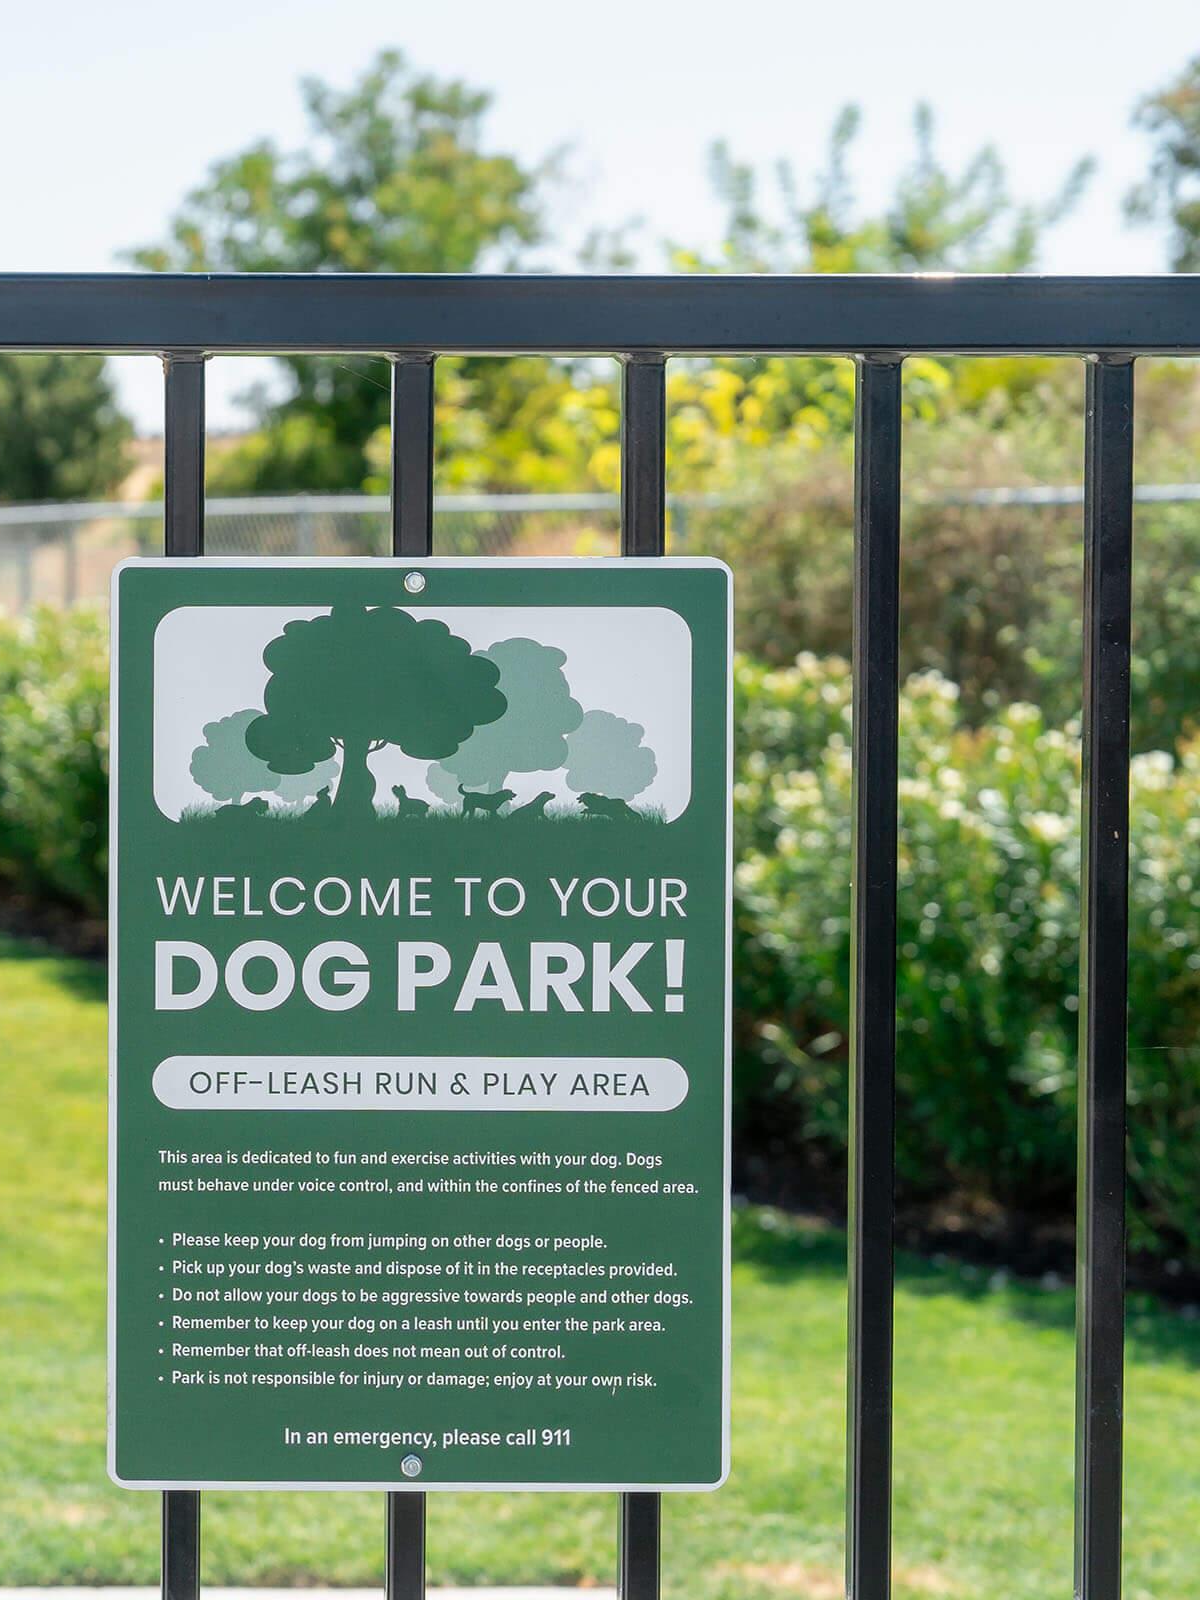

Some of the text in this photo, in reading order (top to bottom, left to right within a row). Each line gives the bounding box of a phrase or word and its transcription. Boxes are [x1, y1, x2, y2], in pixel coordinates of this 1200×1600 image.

[155, 876, 688, 918] WELCOME TO YOUR
[154, 938, 685, 1013] DOG PARK!
[189, 1071, 650, 1097] OFF-LEASH RUN & PLAY AREA
[158, 1149, 663, 1170] This area is dedicated to fun and exercise activities with your dog. Dogs
[158, 1177, 699, 1194] must behave under voice control, and within the confines of the fenced area.
[172, 1232, 608, 1252] Please keep your dog from jumping on other dogs or people.
[172, 1259, 203, 1274] Pick
[206, 1263, 225, 1278] up
[228, 1263, 262, 1278] your
[307, 1261, 352, 1275] waste
[354, 1261, 382, 1275] and
[385, 1260, 442, 1279] dispose
[445, 1261, 461, 1275] of
[463, 1261, 474, 1276] it
[477, 1260, 491, 1276] in
[494, 1261, 519, 1276] the
[522, 1262, 606, 1279] receptacles
[609, 1262, 678, 1280] provided.
[172, 1287, 693, 1308] Do not allow your dogs to be aggressive towards people and other dogs.
[172, 1315, 666, 1335] Remember to keep your dog on a leash until you enter the park area.
[172, 1342, 566, 1359] Remember that off-leash does not mean out of control.
[172, 1370, 657, 1390] Park is not responsible for injury or damage; enjoy at your own risk.
[284, 1427, 571, 1450] In an emergency, please call 911
